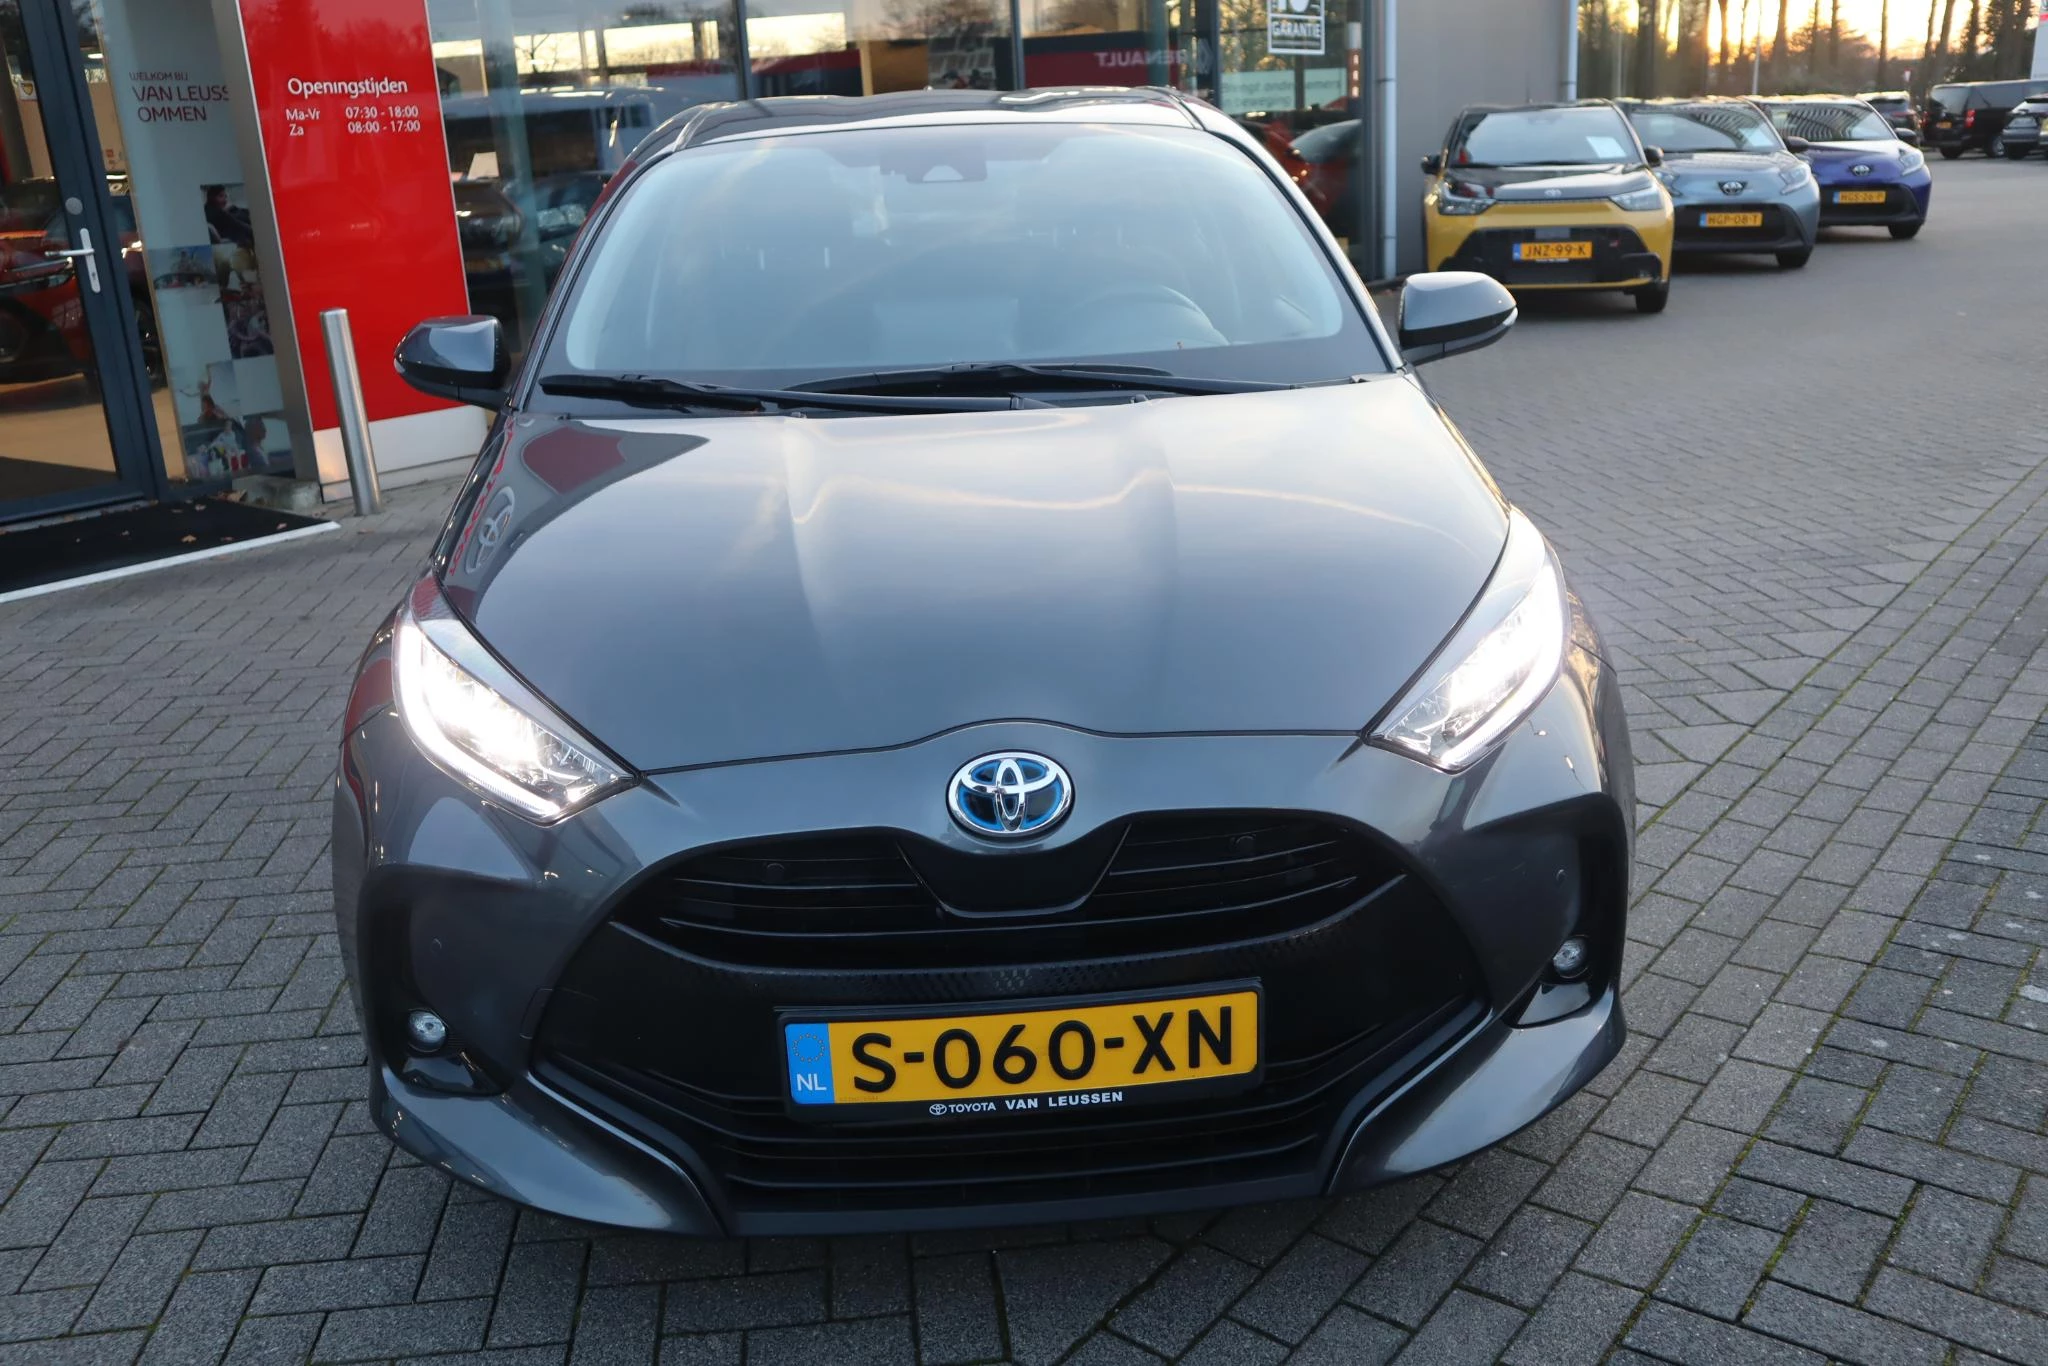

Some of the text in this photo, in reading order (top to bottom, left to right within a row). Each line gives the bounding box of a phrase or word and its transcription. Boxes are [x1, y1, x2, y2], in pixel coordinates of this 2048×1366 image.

[1271, 20, 1321, 38] GARANTIE
[129, 71, 173, 81] WELKOM
[132, 85, 173, 101] VAN
[287, 77, 408, 99] Openingstijden
[137, 105, 207, 122] OMMEN
[286, 108, 320, 120] Ma-Vr
[345, 106, 378, 119] 07:30
[388, 105, 419, 118] 18:00
[289, 123, 304, 136] Za
[347, 120, 380, 133] 08:00
[390, 120, 420, 133] 17:00
[1525, 243, 1587, 257] JNZ-99-K
[852, 1006, 1232, 1093] S-060-XN
[796, 1073, 827, 1092] NL
[948, 1091, 1123, 1114] TOYOTA VAN LEUSSEN
